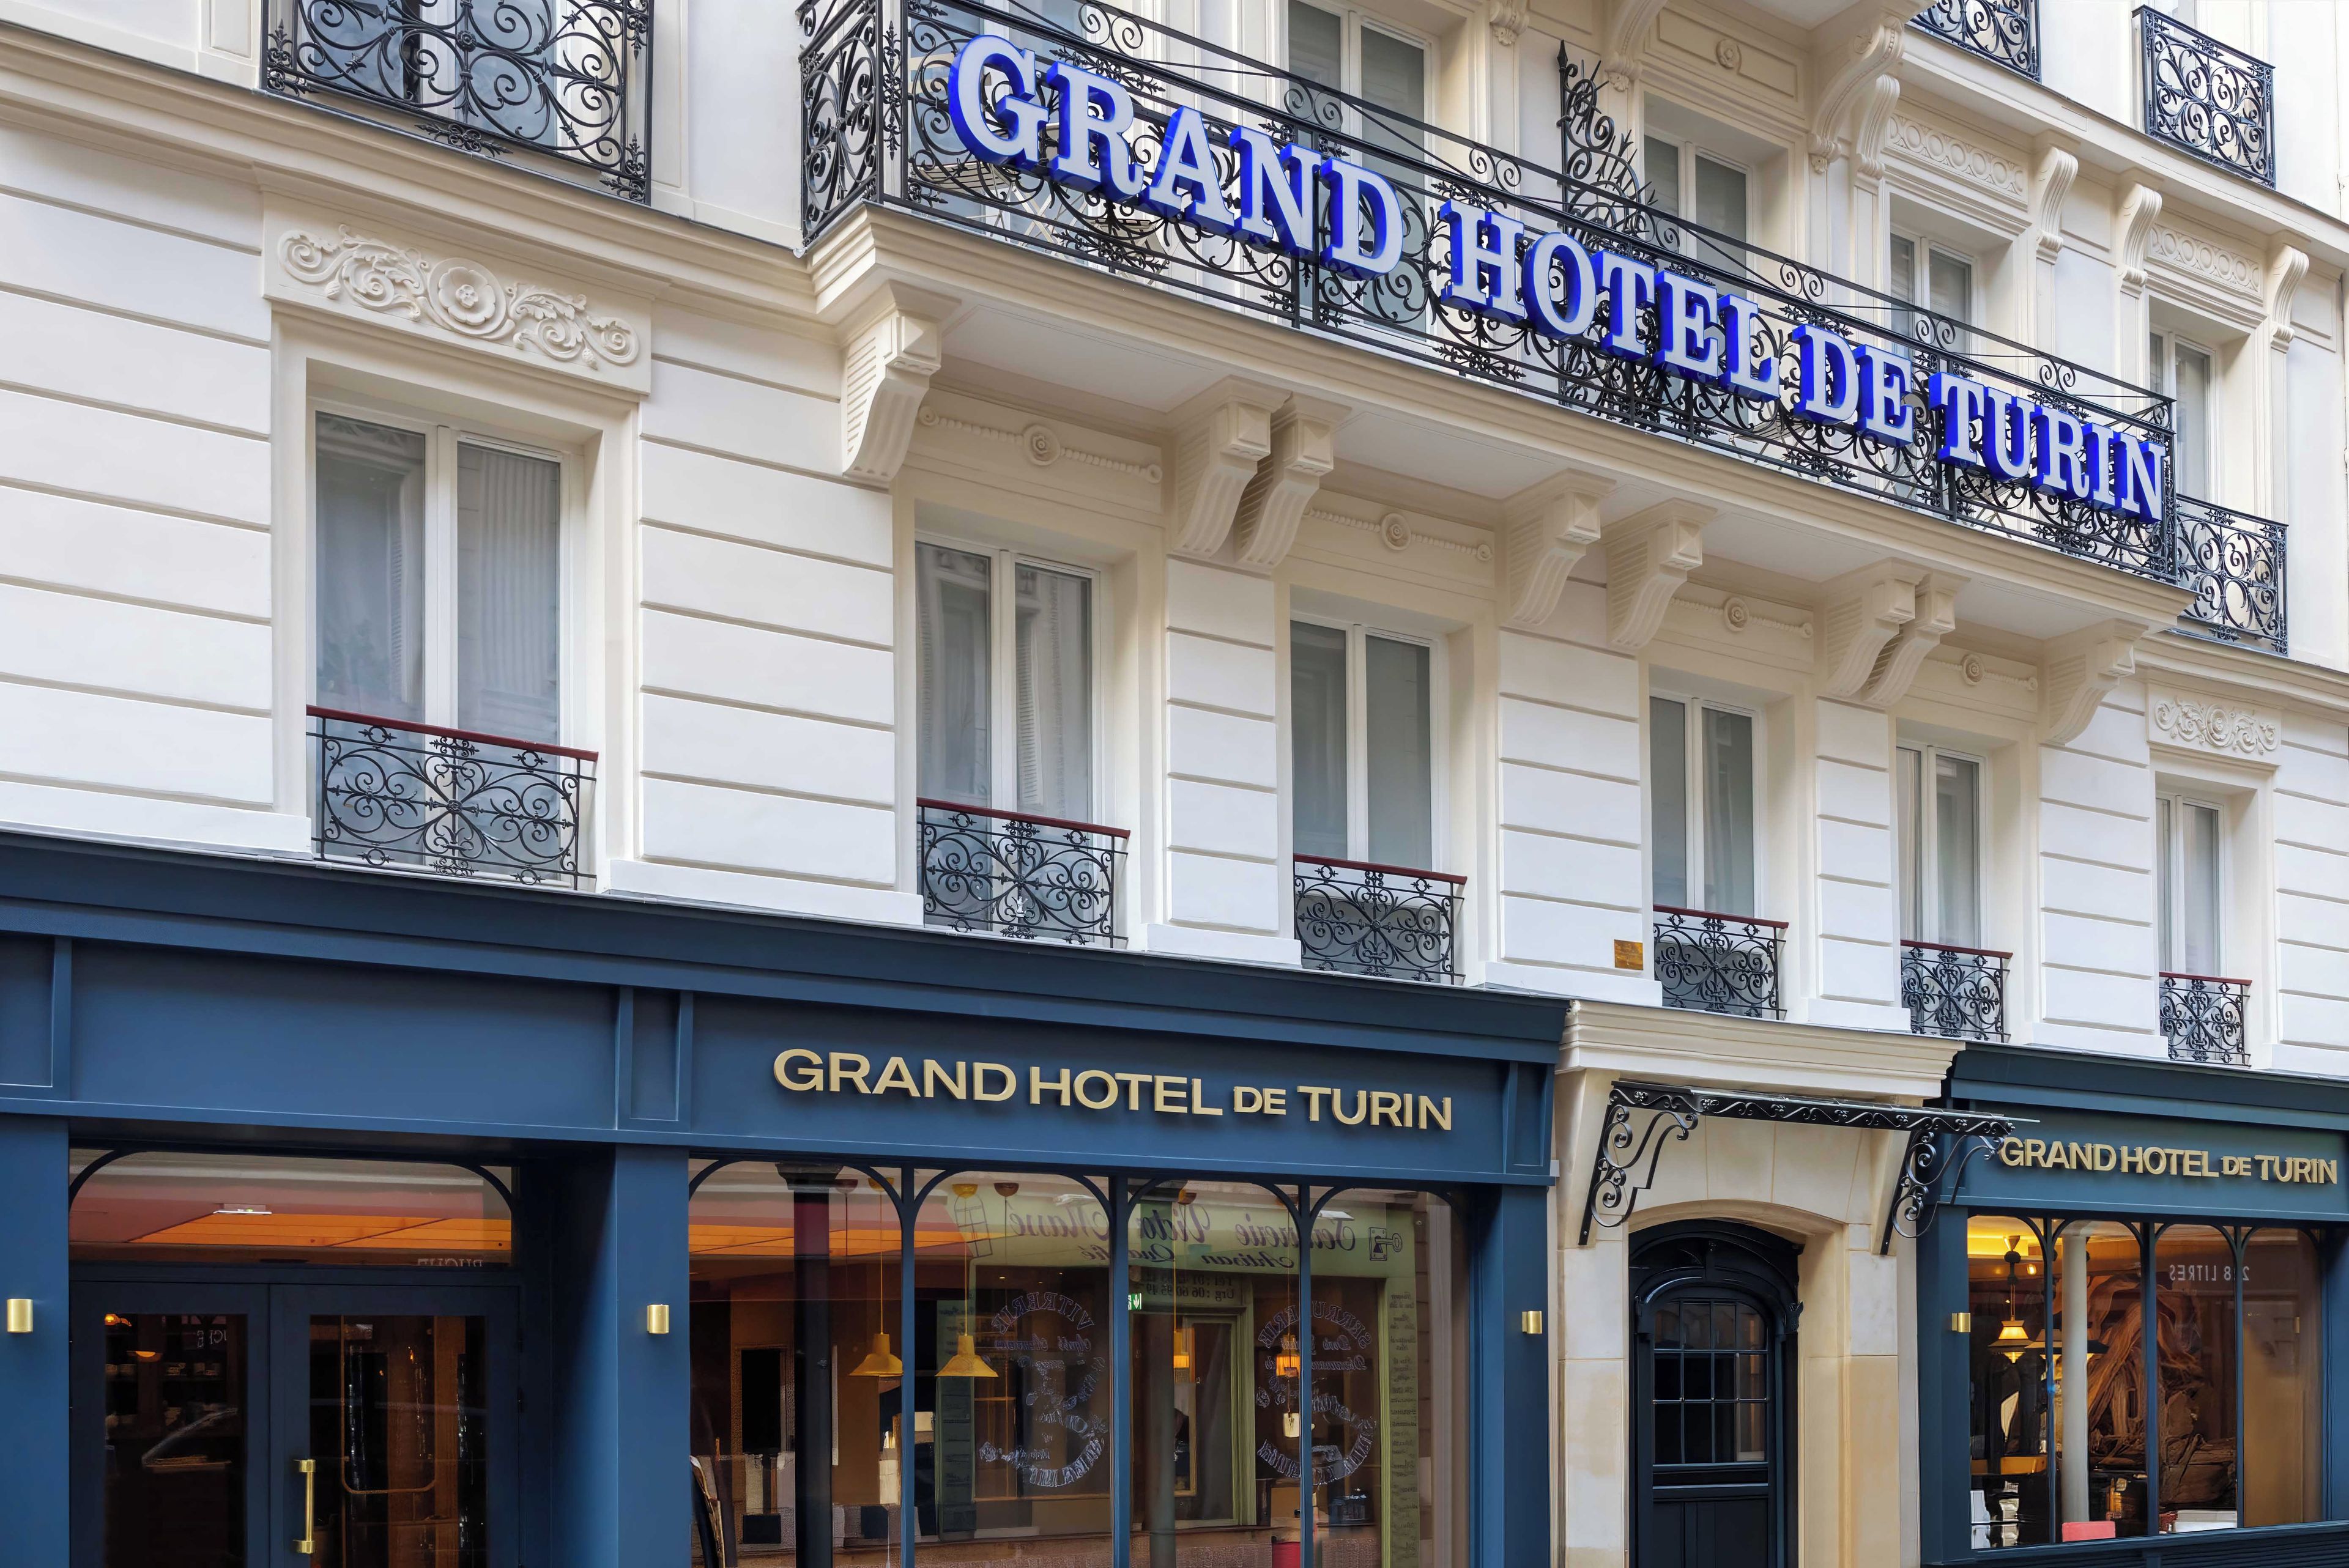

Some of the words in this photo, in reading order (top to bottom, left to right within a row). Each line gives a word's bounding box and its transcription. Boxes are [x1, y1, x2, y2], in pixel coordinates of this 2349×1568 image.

[949, 34, 1405, 281] GRAND
[1439, 199, 1781, 401] HOTEL
[1792, 323, 1914, 446] DE
[1928, 372, 2165, 523] TURIN
[773, 1048, 1017, 1102] GRAND
[1030, 1066, 1223, 1117] HOTEL
[1234, 1086, 1287, 1115] DE
[1297, 1085, 1452, 1131] TURIN
[1999, 1136, 2117, 1172] GRAND
[2120, 1145, 2219, 1178] HOTEL
[2221, 1155, 2252, 1177] DE
[2254, 1154, 2337, 1185] TURIN
